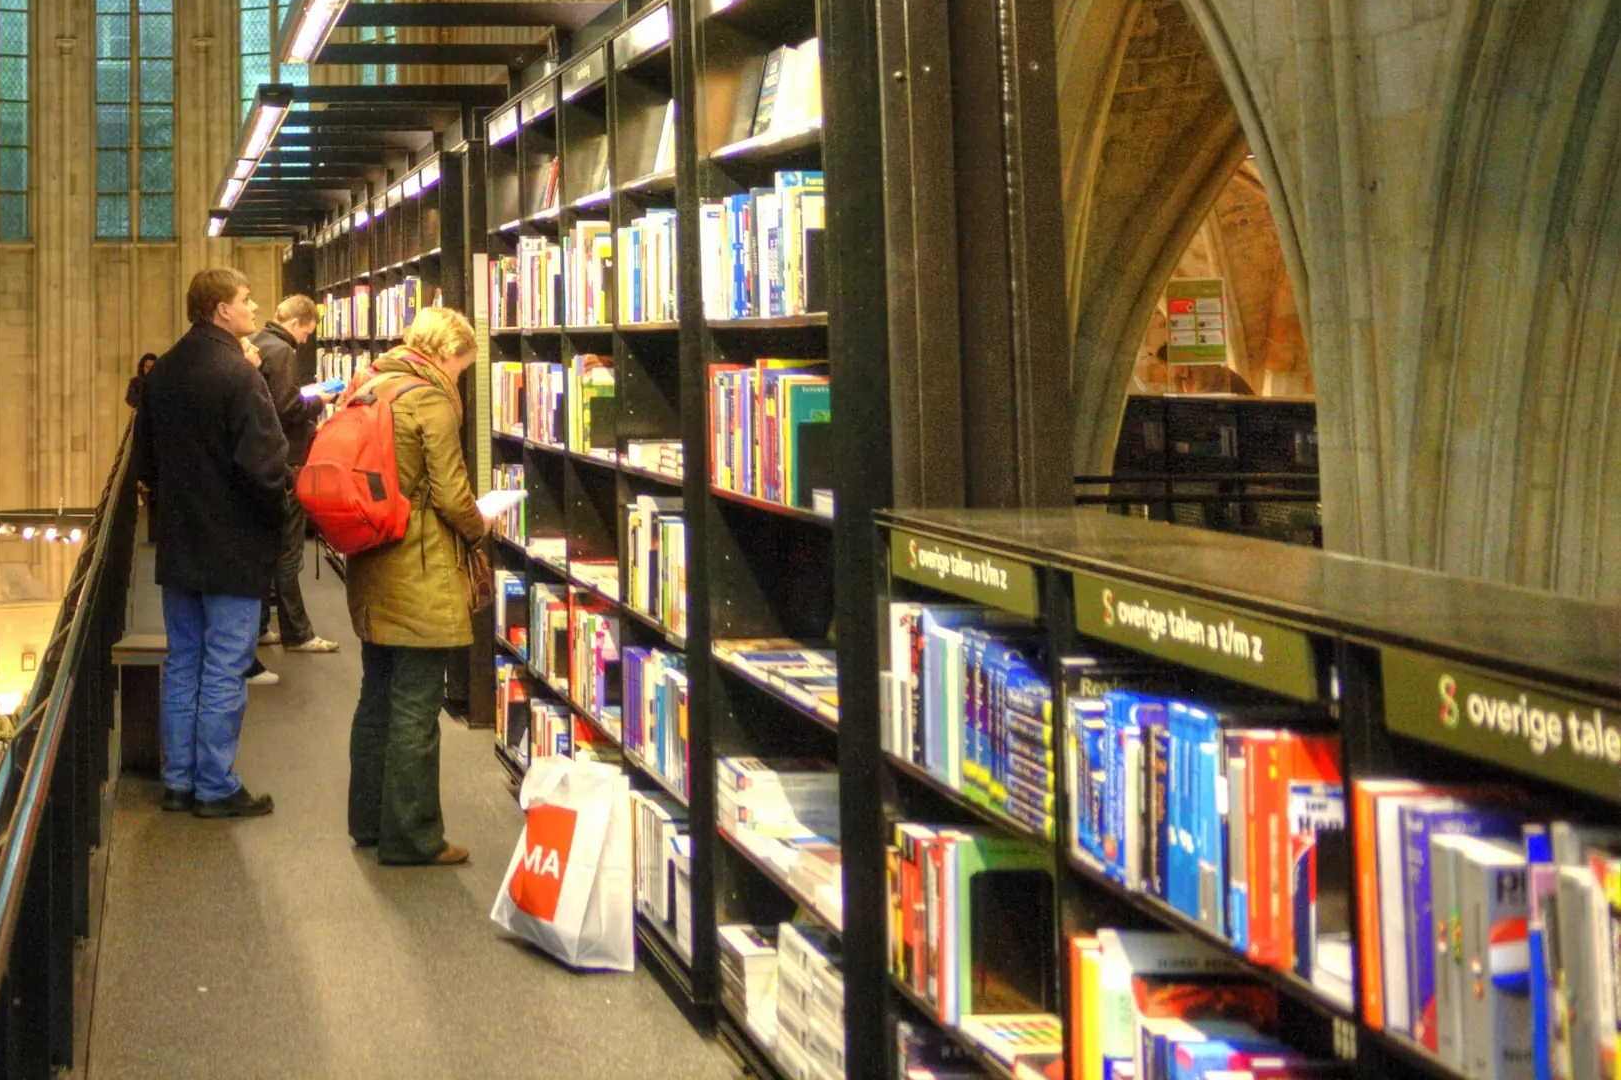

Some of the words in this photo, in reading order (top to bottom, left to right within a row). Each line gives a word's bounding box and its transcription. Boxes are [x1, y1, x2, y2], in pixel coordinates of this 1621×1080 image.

[918, 546, 950, 579] overige
[950, 551, 973, 580] talen
[974, 563, 981, 582] a
[981, 558, 999, 587] t/m
[999, 570, 1008, 590] z
[1116, 600, 1167, 641] overige
[1167, 606, 1205, 646] talen
[1207, 623, 1218, 650] a
[1218, 619, 1249, 658] t/m
[1250, 634, 1264, 663] z
[1466, 692, 1563, 755] overige
[522, 844, 560, 879] MA
